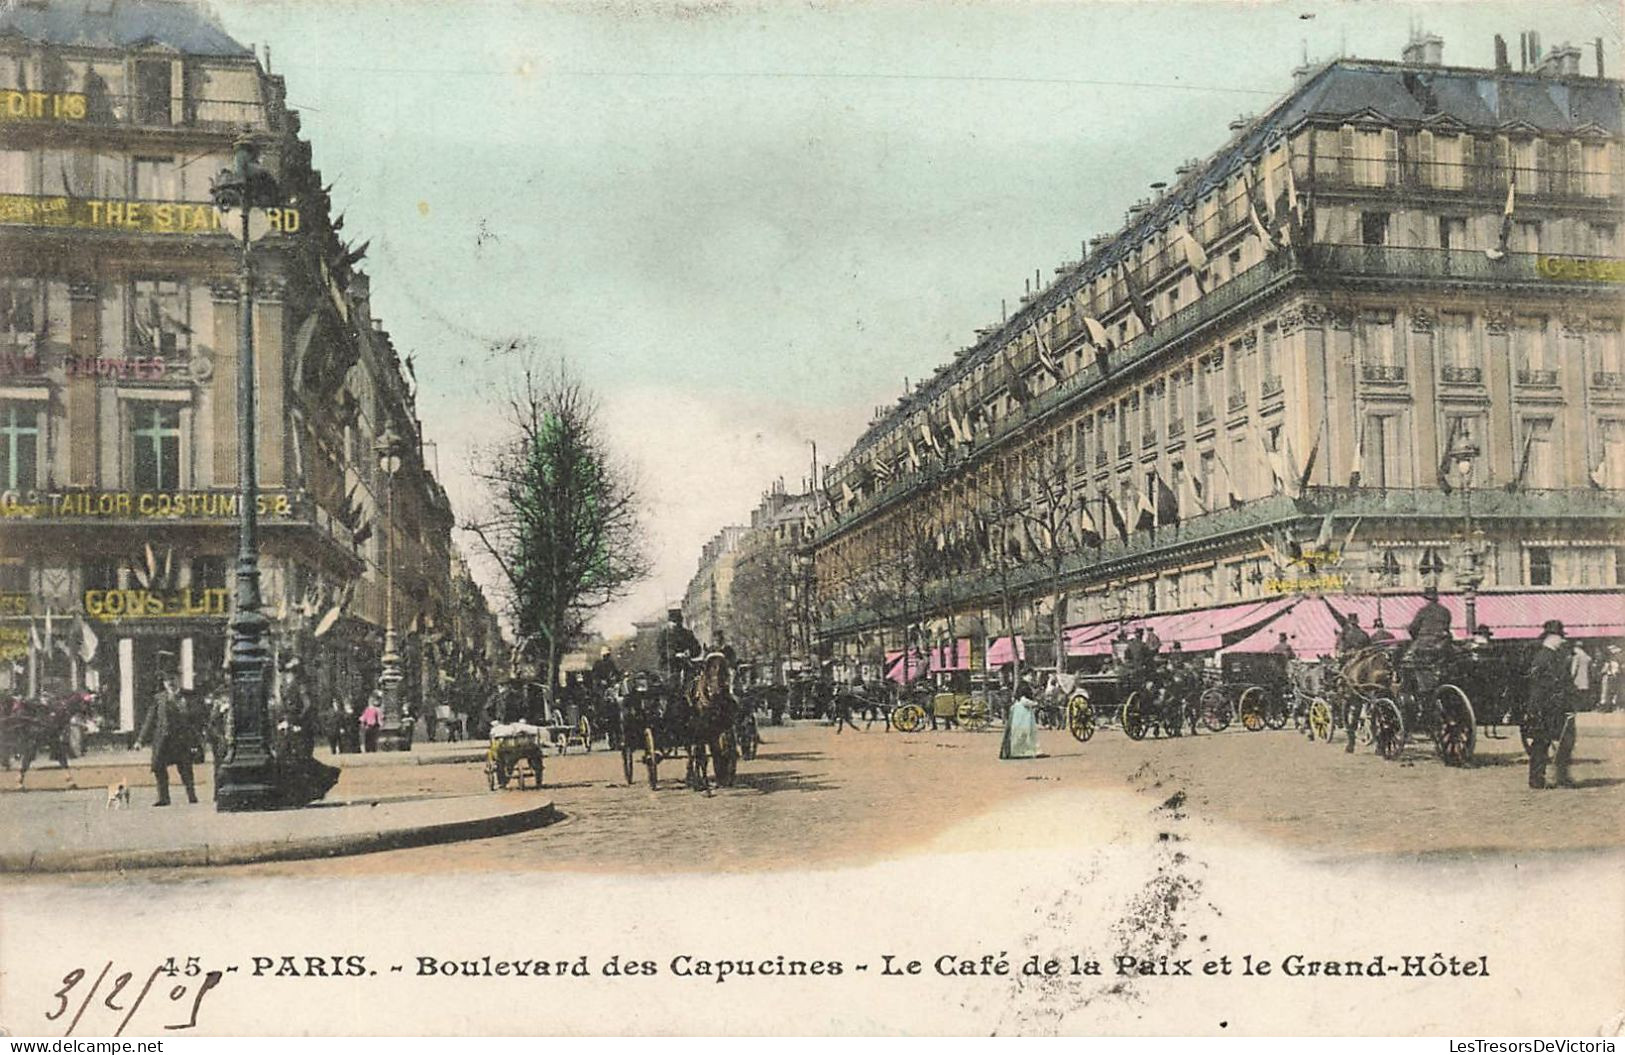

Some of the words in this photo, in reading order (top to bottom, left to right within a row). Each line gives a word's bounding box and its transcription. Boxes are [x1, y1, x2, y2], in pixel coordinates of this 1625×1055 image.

[88, 201, 141, 225] THE
[48, 493, 130, 514] TAILOR
[252, 956, 377, 977] PARIS.
[417, 956, 591, 977] Boulevard
[602, 956, 658, 977] des
[670, 956, 843, 984] Capucines
[881, 956, 922, 977] Le
[934, 951, 1009, 977] Café
[1022, 956, 1060, 976] de
[1071, 955, 1101, 976] la
[1115, 955, 1192, 976] Paix
[1203, 956, 1232, 976] et
[1243, 955, 1271, 977] le
[1281, 952, 1490, 977] Grand-Hôtel
